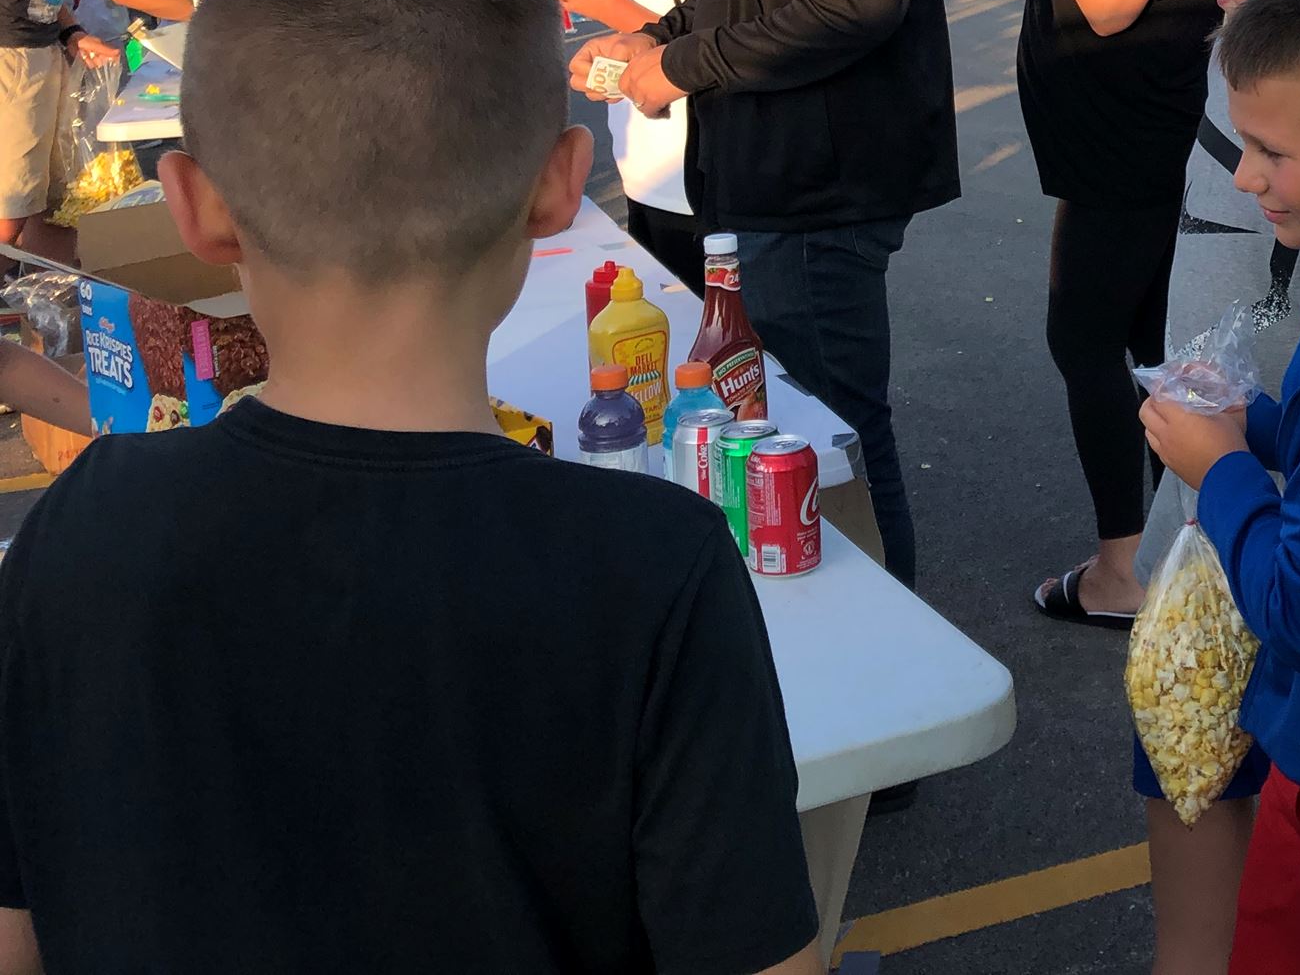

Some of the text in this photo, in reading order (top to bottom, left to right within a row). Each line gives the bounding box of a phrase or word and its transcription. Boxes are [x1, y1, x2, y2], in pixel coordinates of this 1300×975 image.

[80, 281, 92, 301] 60
[88, 346, 133, 388] TREATS
[635, 352, 653, 365] DELI
[698, 444, 708, 469] Coke
